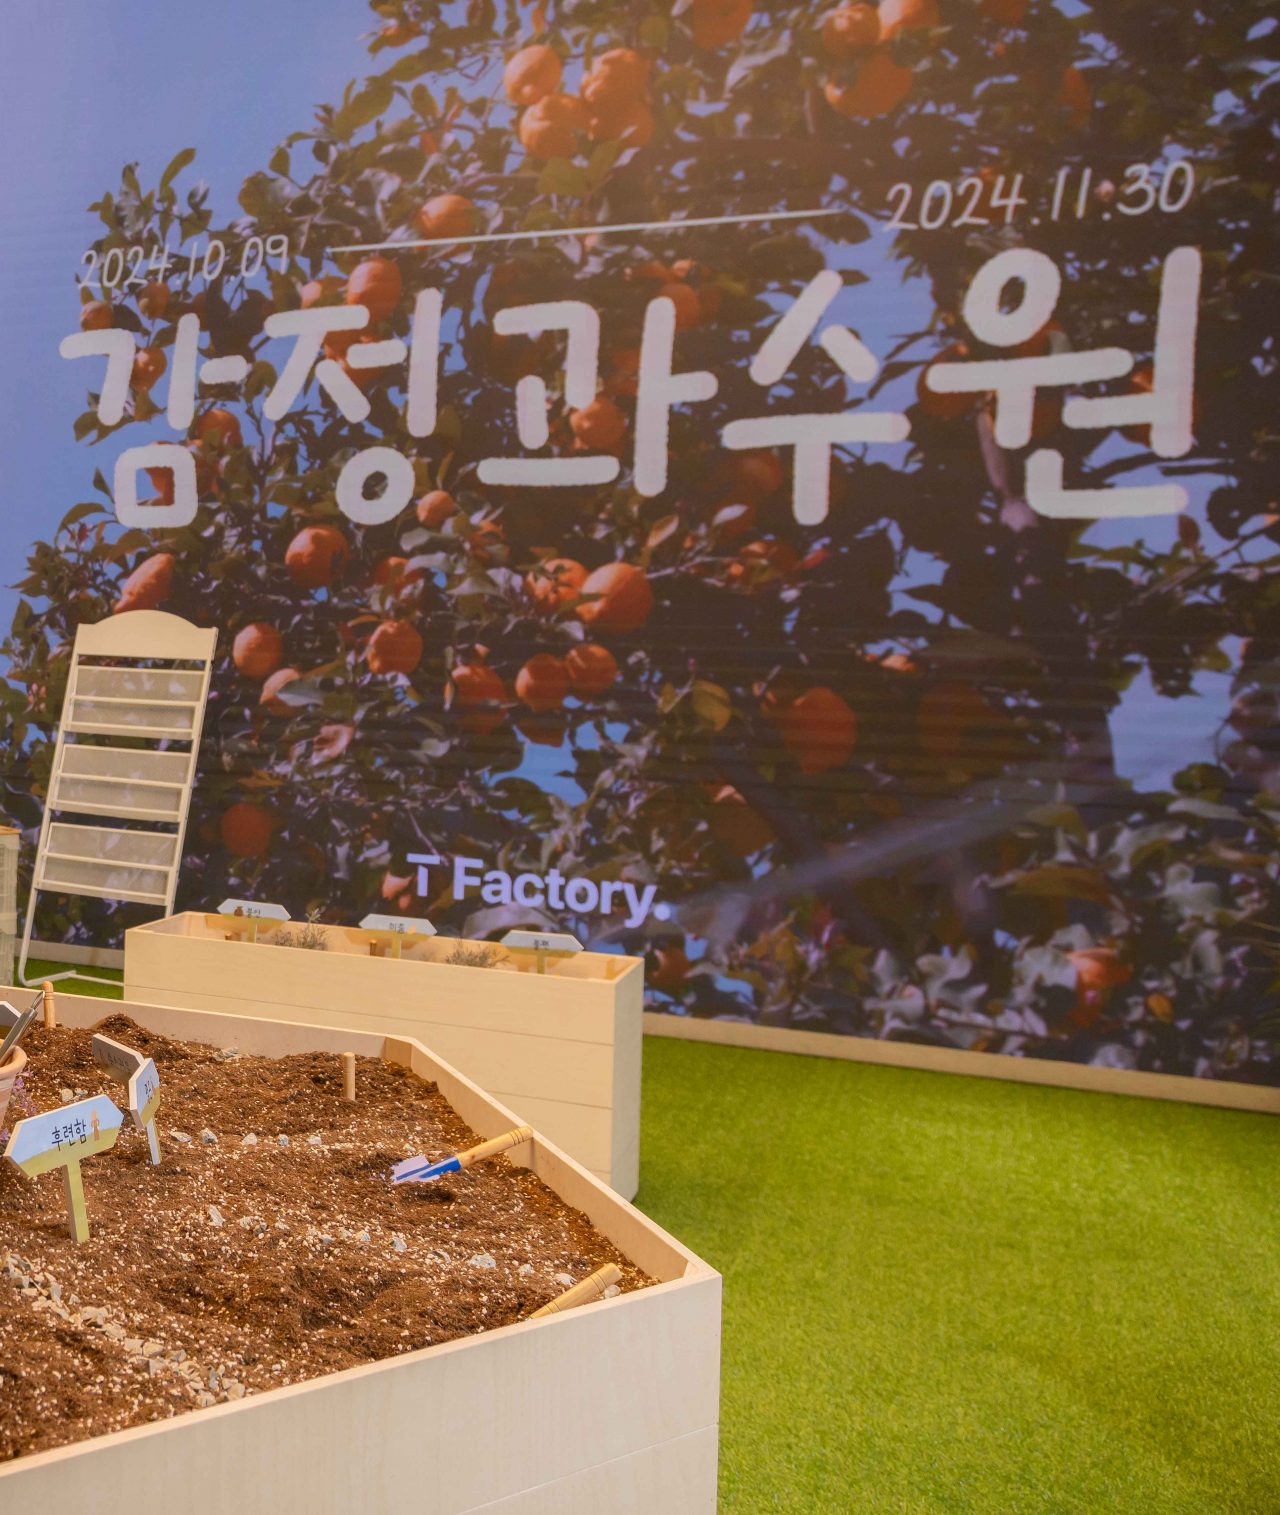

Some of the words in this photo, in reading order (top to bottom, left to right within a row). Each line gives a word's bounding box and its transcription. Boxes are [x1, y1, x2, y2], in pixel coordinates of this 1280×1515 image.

[883, 160, 1195, 232] 2024.11.30
[77, 235, 289, 288] 2024.10.09
[59, 245, 1202, 529] 감정과수원
[406, 852, 441, 897] T
[51, 1118, 87, 1152] 후련함
